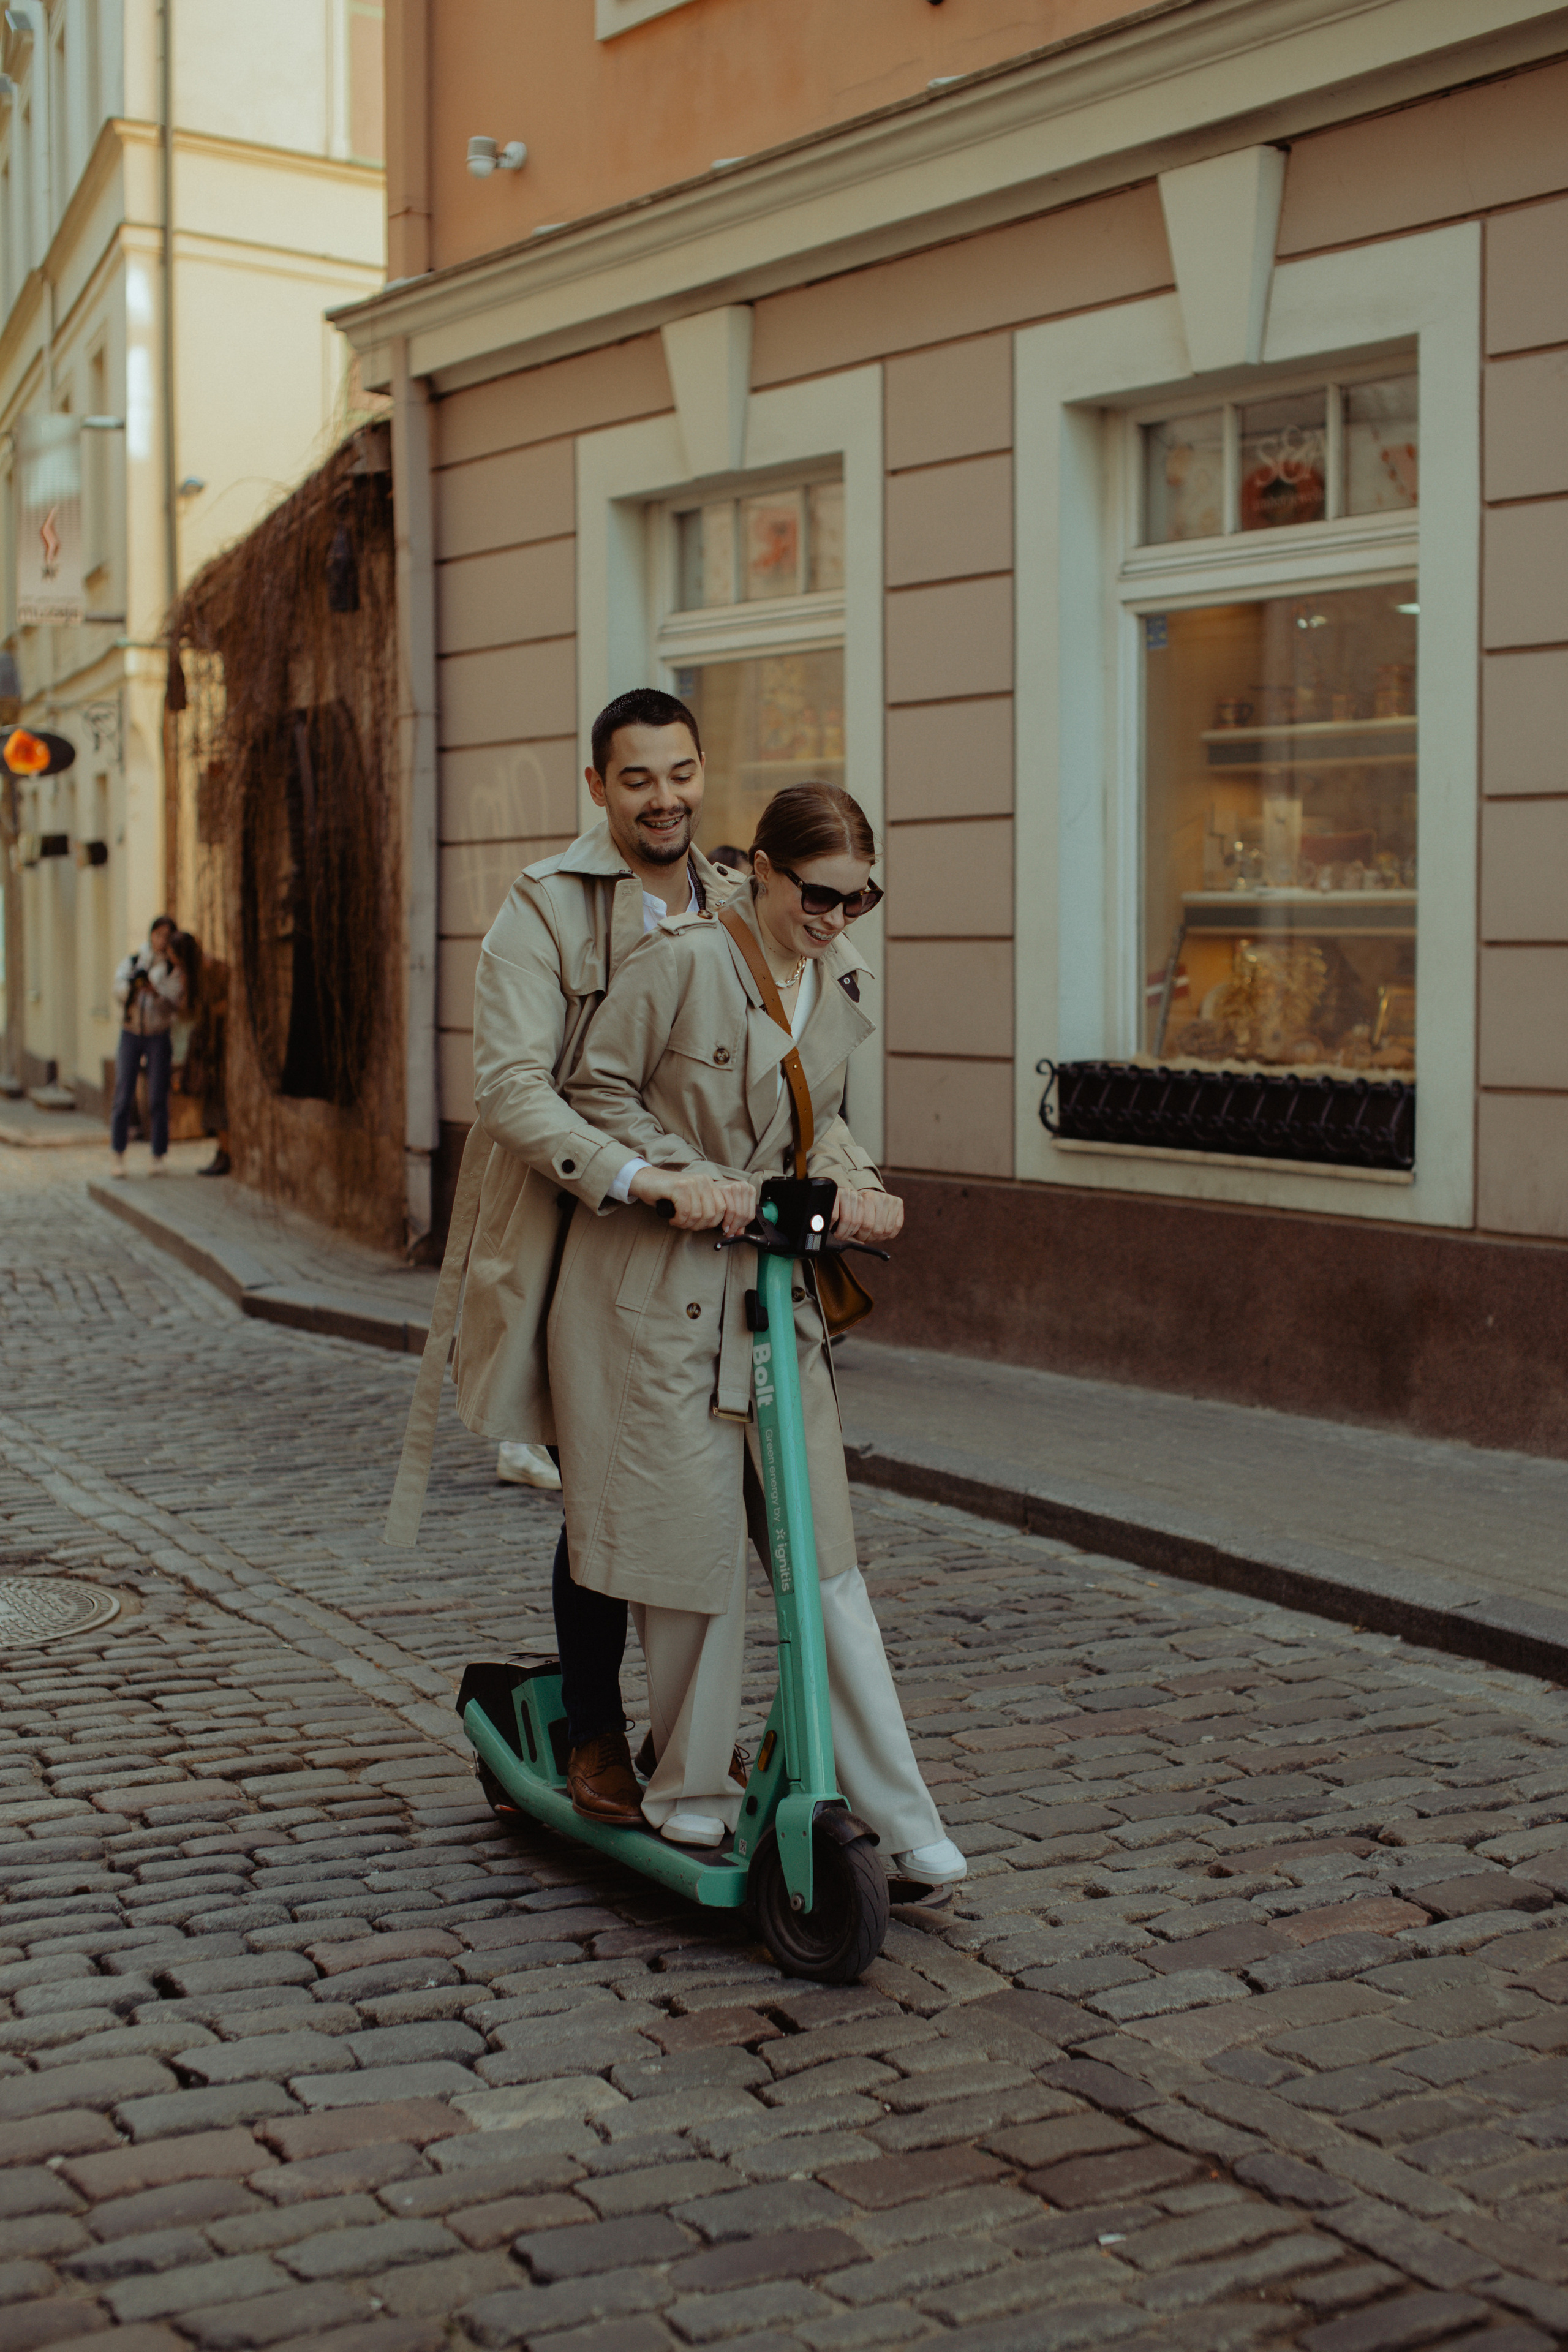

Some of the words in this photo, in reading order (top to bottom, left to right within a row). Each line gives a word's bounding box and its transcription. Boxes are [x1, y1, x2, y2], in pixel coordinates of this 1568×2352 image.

[753, 1343, 775, 1408] Bolt
[766, 1429, 775, 1464] Green
[769, 1466, 779, 1505] energy
[774, 1507, 781, 1521] by
[775, 1543, 791, 1592] ignitis
